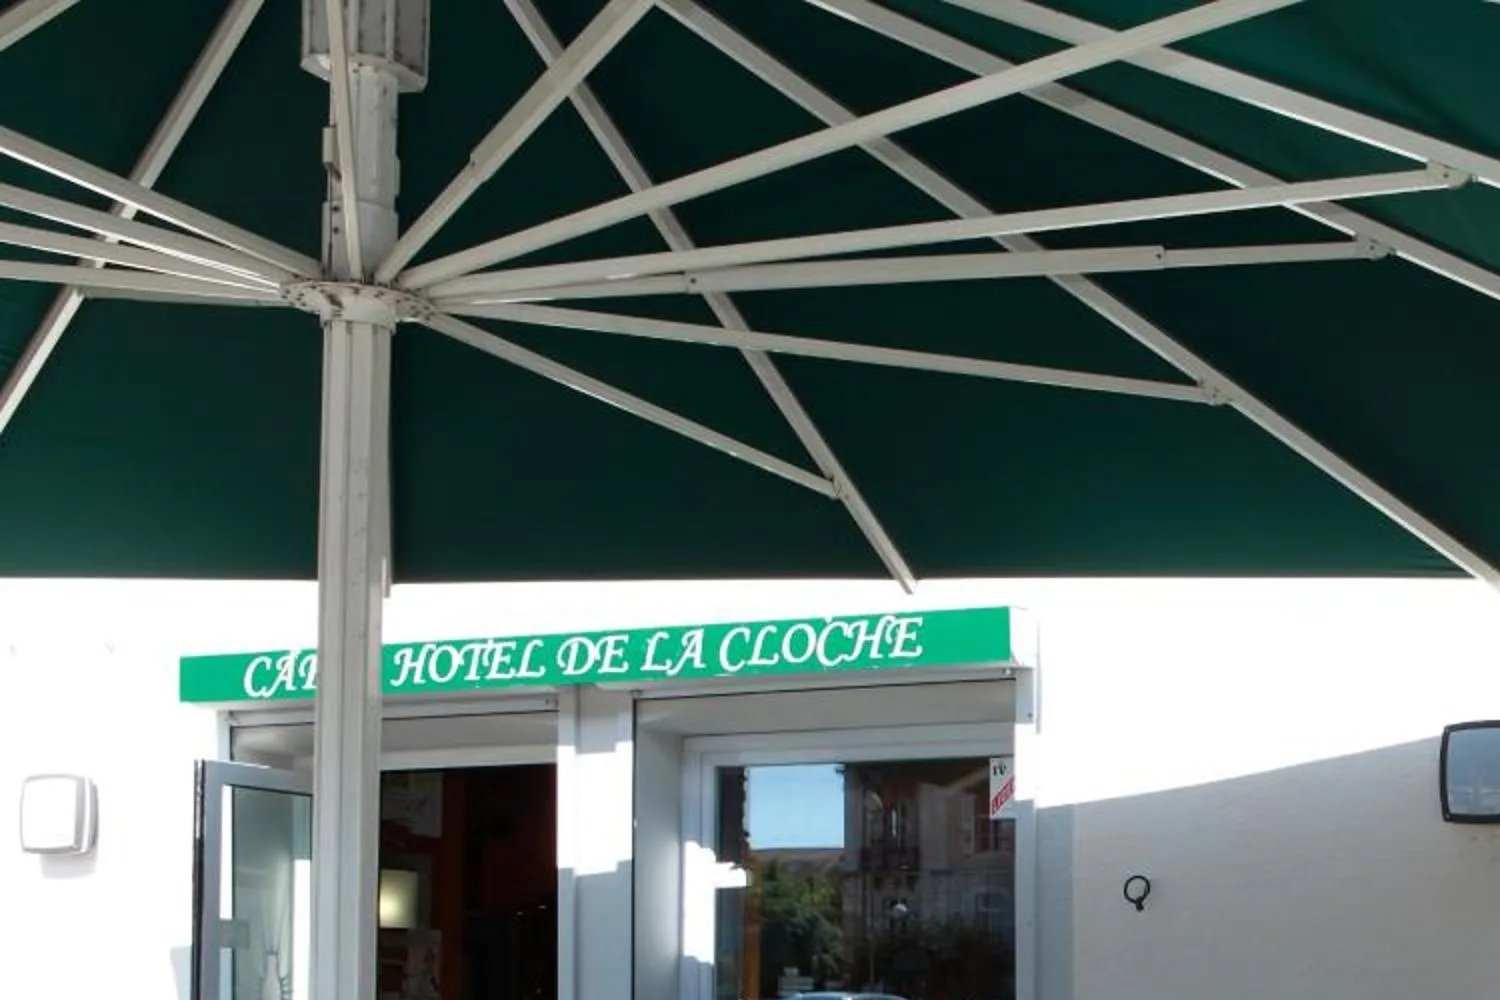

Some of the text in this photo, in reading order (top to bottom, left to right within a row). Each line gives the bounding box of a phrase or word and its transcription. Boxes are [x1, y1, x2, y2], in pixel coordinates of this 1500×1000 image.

[243, 614, 924, 698] CAF HOTEL DE LA CLOCHE
